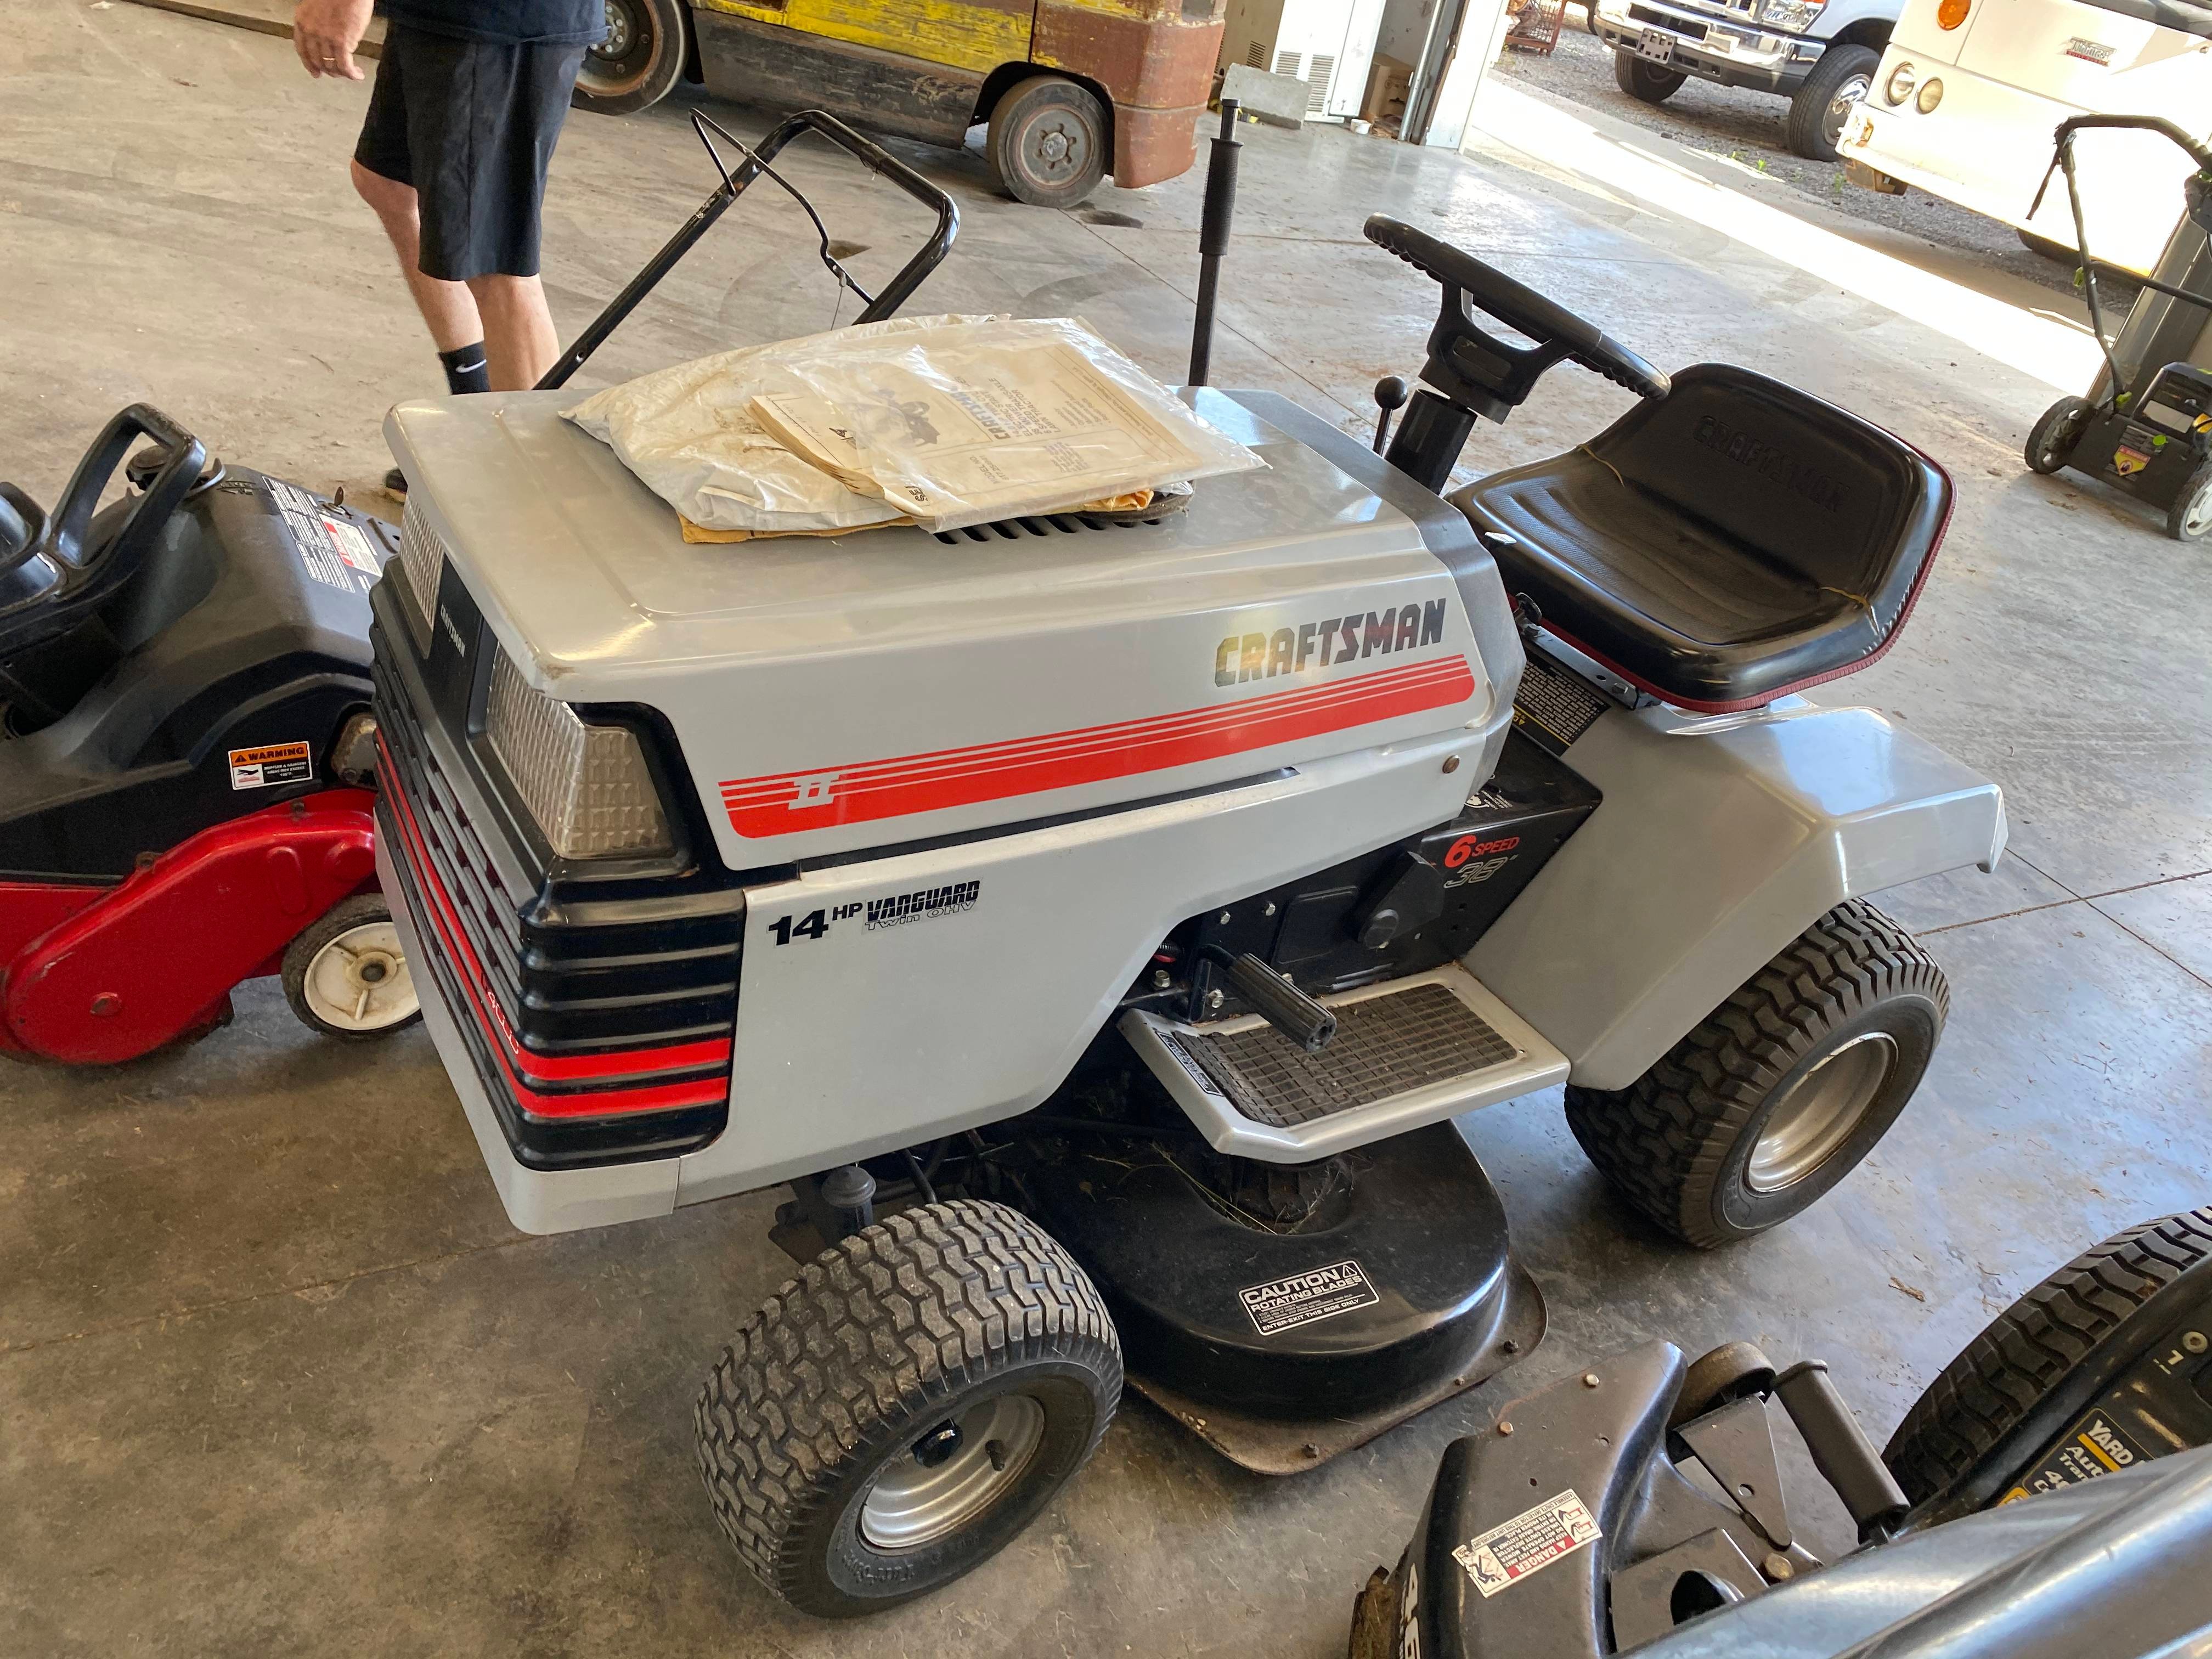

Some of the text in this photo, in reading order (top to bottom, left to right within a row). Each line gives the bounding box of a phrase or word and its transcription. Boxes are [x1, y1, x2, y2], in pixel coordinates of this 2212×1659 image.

[988, 377, 1027, 410] TRANSAXLE
[979, 390, 1033, 436] ELECTRIC START
[1004, 403, 1032, 425] MOWER
[1011, 389, 1062, 432] LAWN TRACTOR
[1023, 410, 1047, 429] SPEED
[979, 465, 1001, 484] MODEL
[1215, 598, 1446, 687] CRAFTSMAN
[248, 747, 304, 761] WARNING
[1444, 834, 1520, 868] 6 SPEED
[769, 880, 980, 946] 14 HP VANGUARD
[865, 900, 977, 931] Twin OHV
[1244, 1268, 1341, 1304] CAUTION
[1250, 1290, 1312, 1312] ROTATING
[1311, 1276, 1362, 1295] BLADES
[1305, 1309, 1323, 1319] THIS
[1323, 1304, 1341, 1313] SIDE
[1341, 1298, 1359, 1307] ONLY
[2087, 1419, 2134, 1465] YARD
[1541, 1503, 1555, 1513] CHUTE
[1553, 1493, 1573, 1506] ASSEMBLE
[1519, 1510, 1542, 1524] DEFLECTOR
[1520, 1518, 1539, 1531] PROPER
[1532, 1519, 1549, 1531] ENTIRE
[1494, 1528, 1506, 1537] UNIT
[1504, 1523, 1515, 1532] THIS
[1518, 1527, 1533, 1538] GRASS
[1544, 1530, 1556, 1539] NOT
[1496, 1521, 1560, 1557] UNLESS CHUTE DEFLECTOR
[1497, 1535, 1520, 1549] CATCHER
[1521, 1536, 1545, 1551] OPERATE
[1538, 1537, 1556, 1549] HANDS
[1499, 1549, 1521, 1562] MOWER
[1517, 1551, 1531, 1560] FEET
[1528, 1545, 1541, 1554] AND
[1517, 1548, 1558, 1573] DANGER
